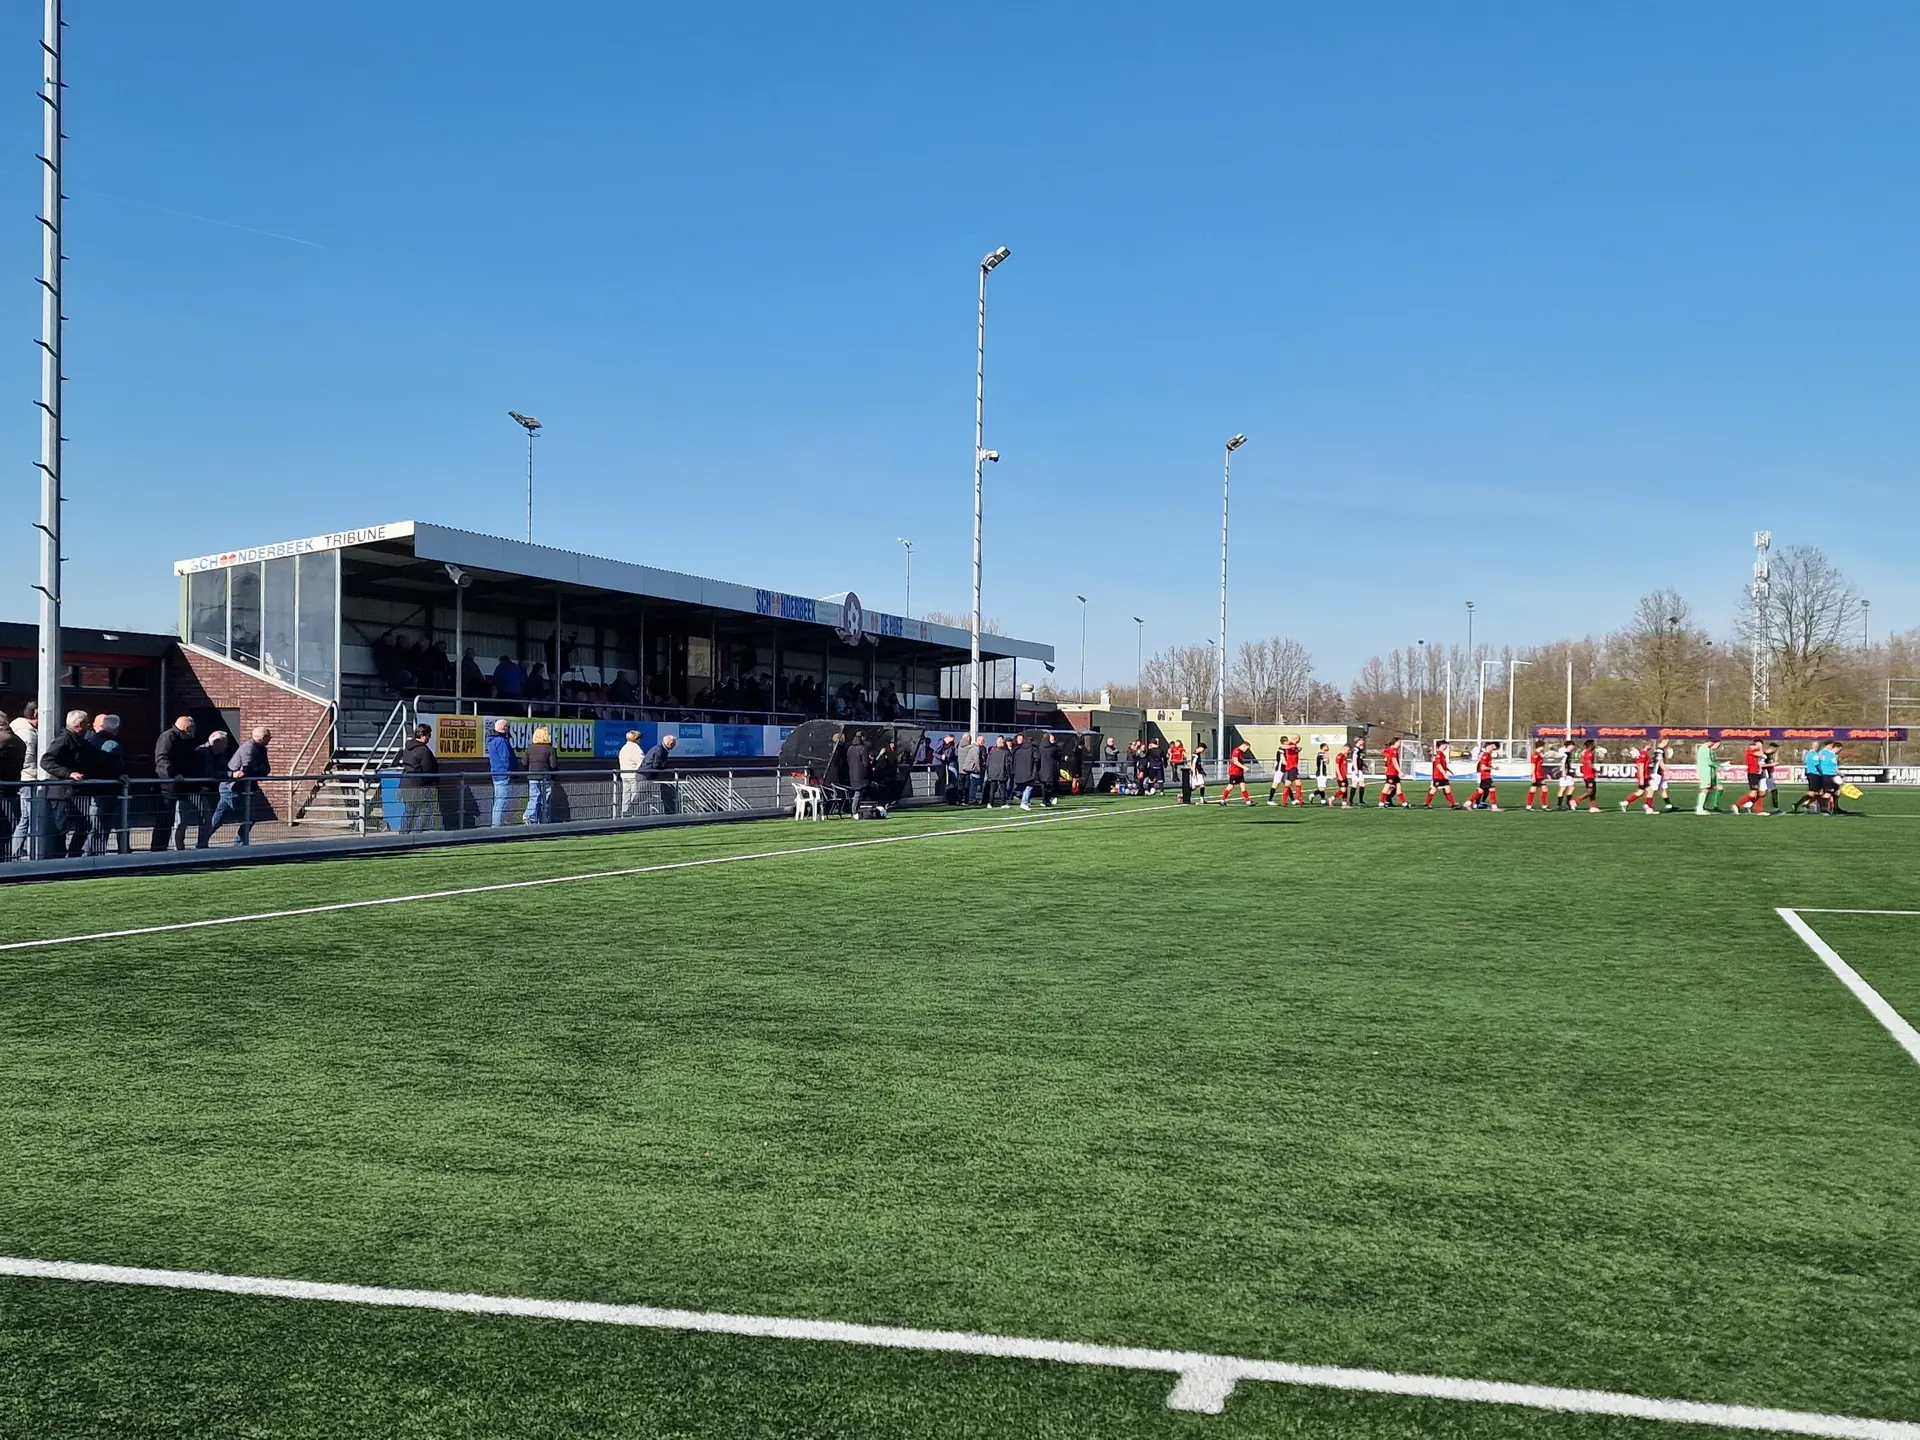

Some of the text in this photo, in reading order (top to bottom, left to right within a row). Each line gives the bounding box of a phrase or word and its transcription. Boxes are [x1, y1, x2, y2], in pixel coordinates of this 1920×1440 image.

[324, 527, 386, 548] TRIBUNE
[440, 739, 477, 754] VIA DE APP!
[561, 723, 593, 751] CODE!
